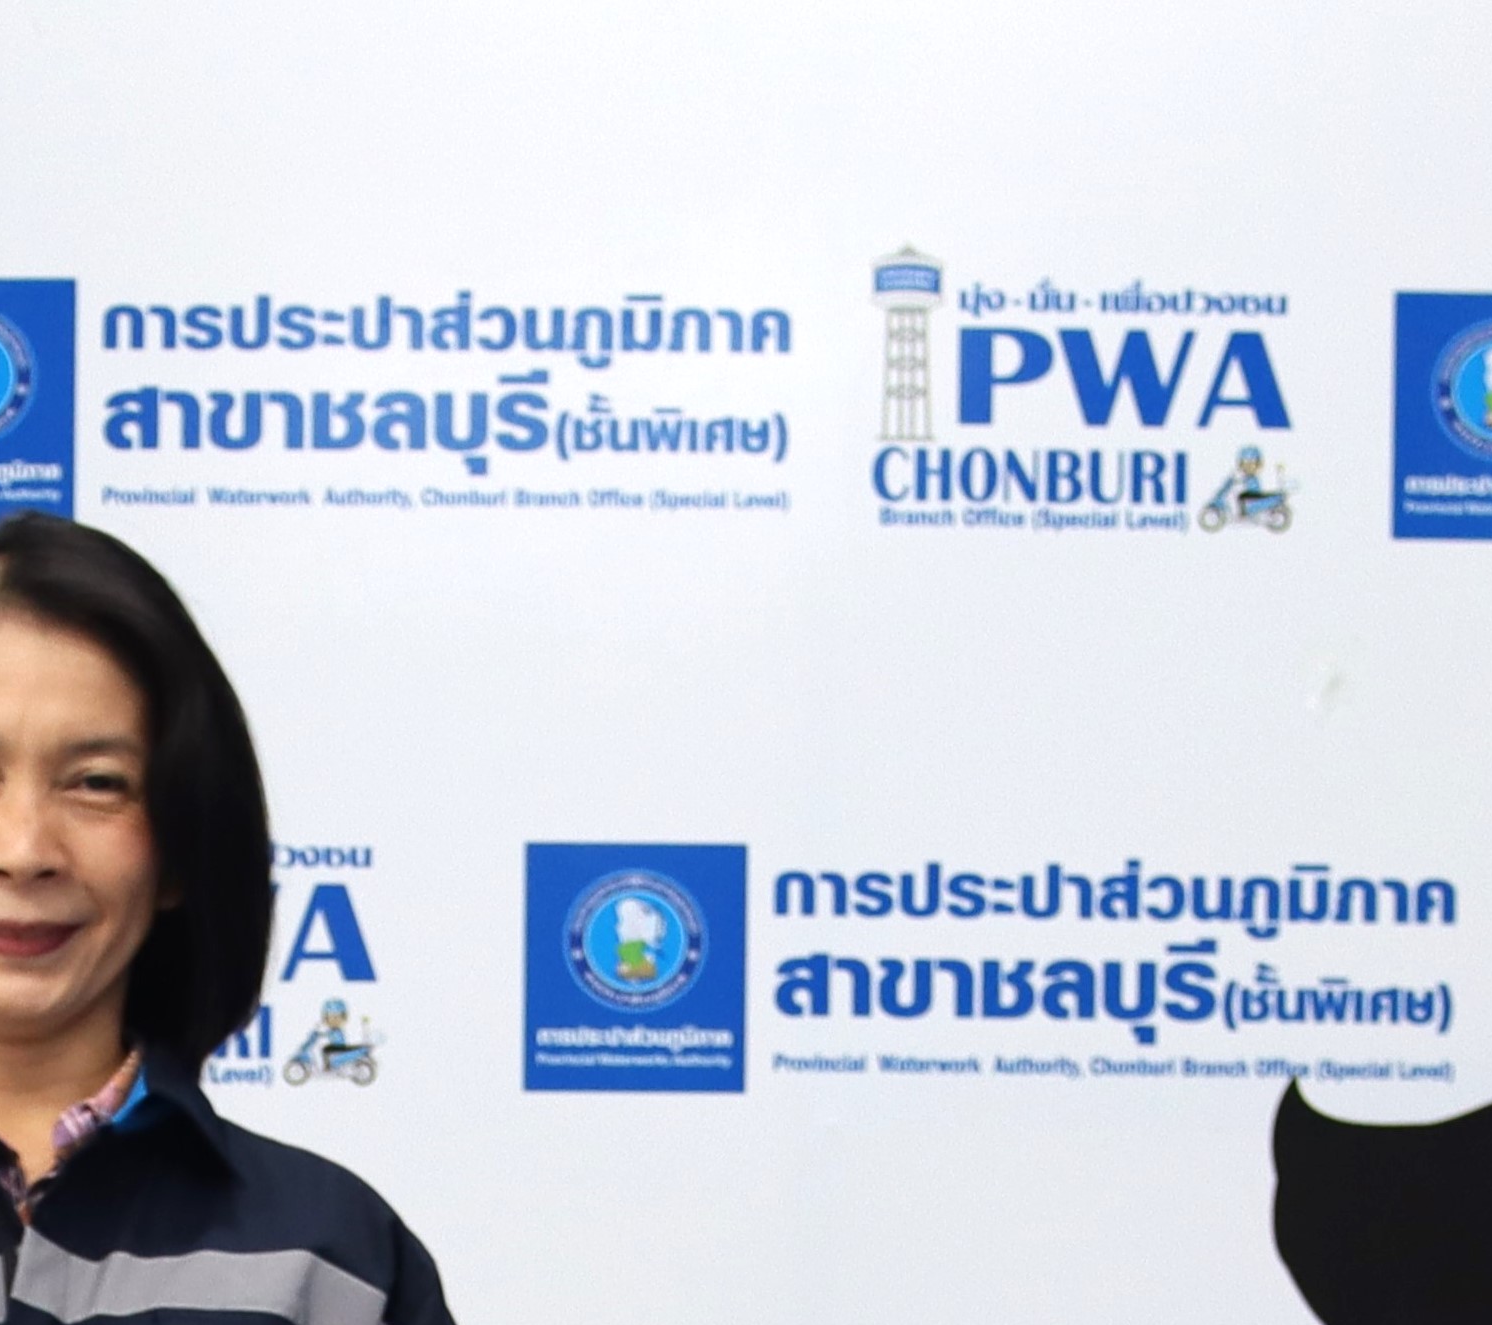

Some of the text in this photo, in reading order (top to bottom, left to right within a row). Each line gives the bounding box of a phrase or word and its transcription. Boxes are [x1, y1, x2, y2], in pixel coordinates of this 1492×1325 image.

[101, 290, 792, 369] การประปาส่วนภูมิภาค
[959, 327, 1291, 429] PWA
[101, 369, 788, 475] สาขาชลบุรี(ชั้นพิเศษ)
[872, 446, 1188, 504] CHONBURI
[879, 505, 955, 527] Branch
[774, 856, 1456, 938] การประปาส่วนภูมิภาค
[774, 941, 1455, 1046] สาขาชลบุรี(ชั้นพิเศษ)
